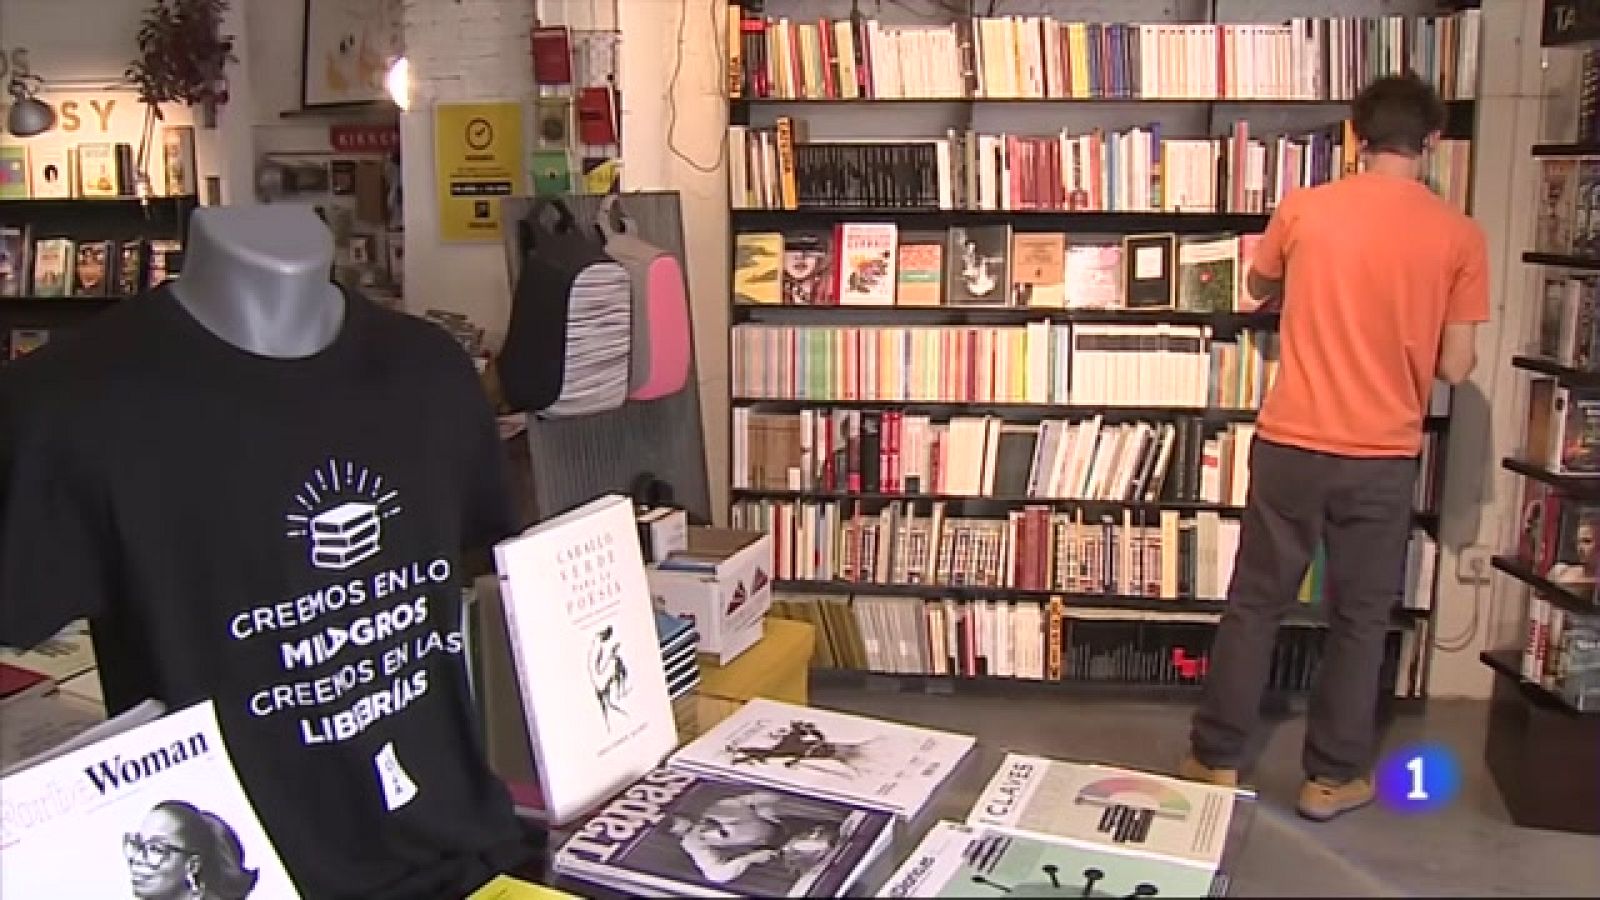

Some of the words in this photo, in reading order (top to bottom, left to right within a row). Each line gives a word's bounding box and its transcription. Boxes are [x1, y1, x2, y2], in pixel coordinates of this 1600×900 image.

[374, 566, 409, 598] EN
[411, 559, 451, 586] LO
[382, 641, 409, 676] EN
[414, 630, 463, 660] LAS
[84, 731, 209, 795] Woman
[985, 762, 1035, 817] CLAVES
